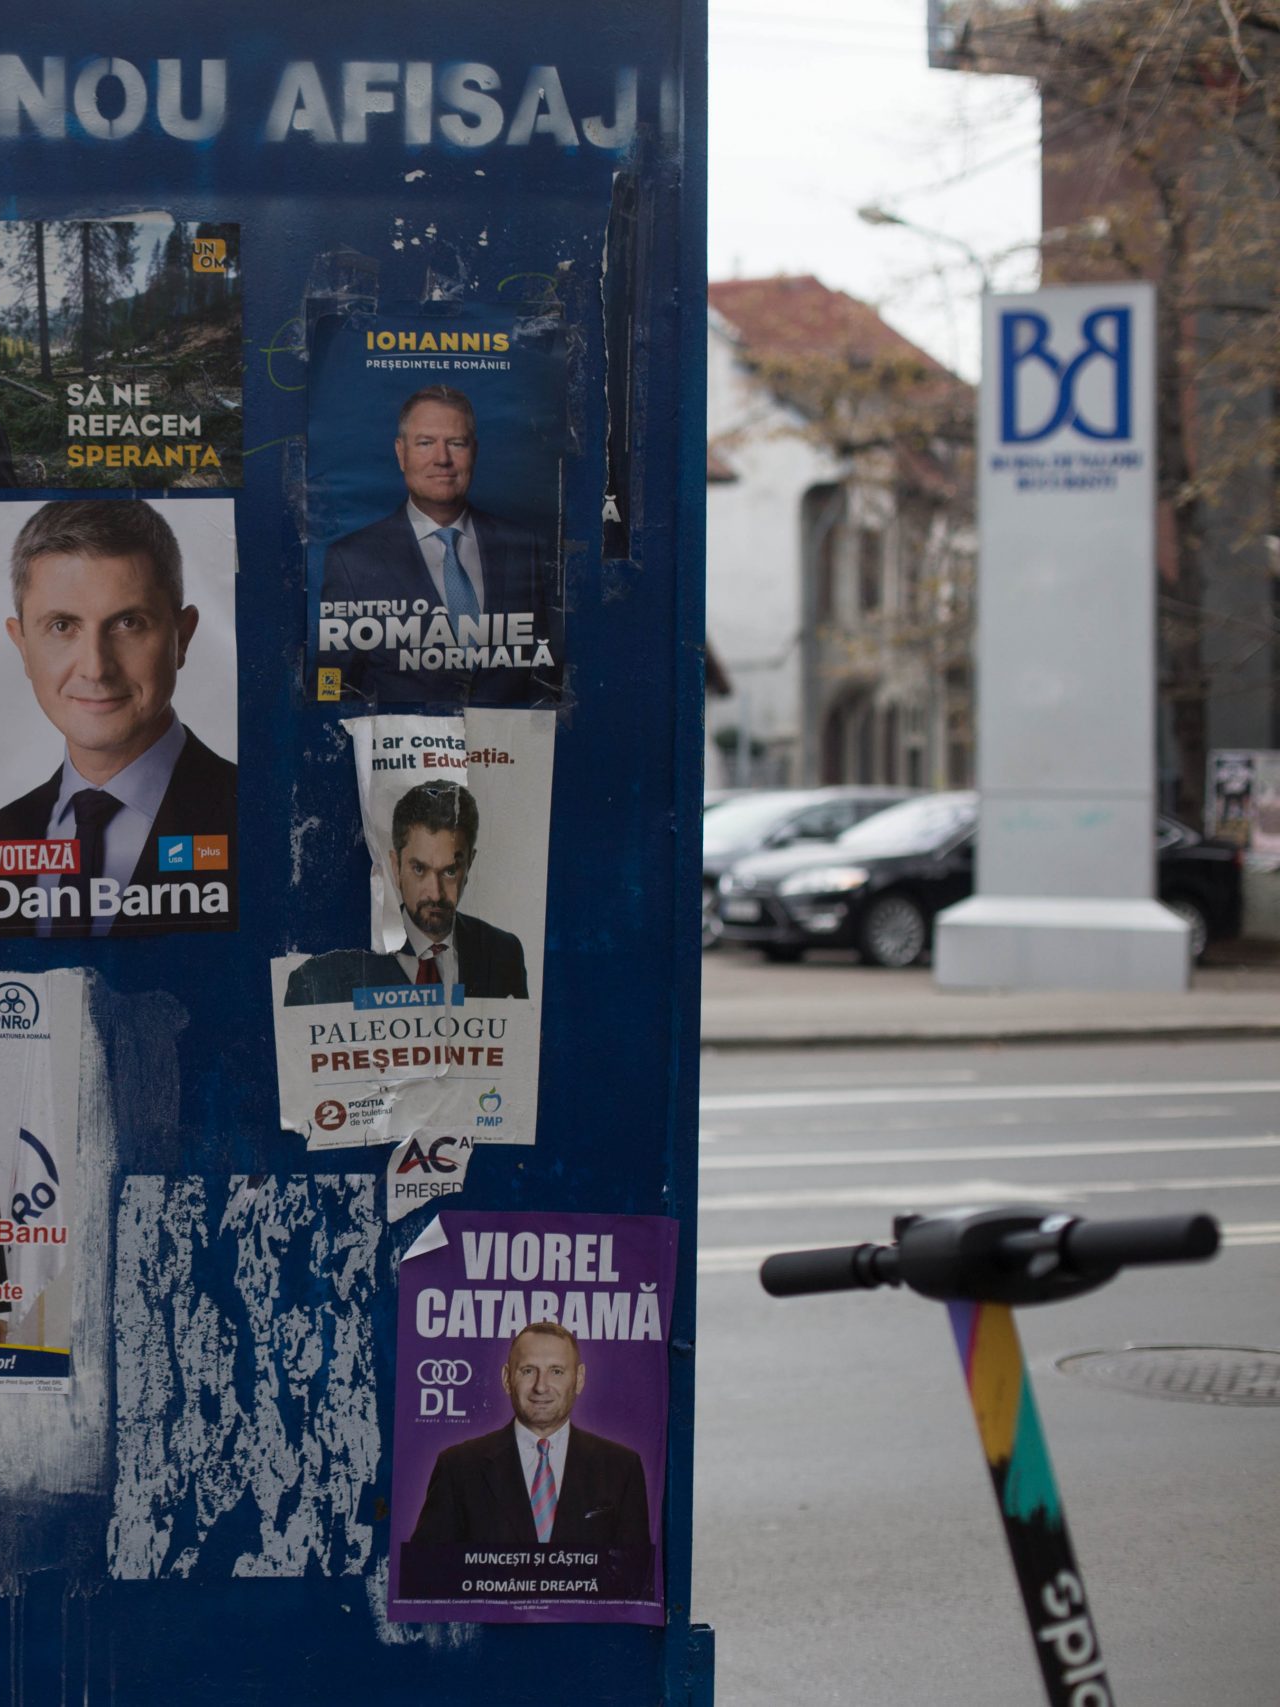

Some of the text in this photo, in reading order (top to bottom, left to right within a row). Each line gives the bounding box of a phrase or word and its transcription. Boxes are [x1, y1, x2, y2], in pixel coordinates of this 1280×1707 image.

[263, 60, 638, 149] AFISAJ
[193, 242, 215, 255] UN
[366, 331, 510, 351] IOHANNIS
[366, 360, 511, 371] PREȘEDINTELE ROMÂNIEI
[67, 375, 151, 406] SĂ NE
[68, 414, 201, 437] REFACEM
[67, 445, 222, 475] SPERANȚA
[320, 598, 429, 618] PENTRU O
[319, 606, 535, 651] ROMÂNIE
[399, 638, 555, 671] NORMALĂ
[382, 737, 404, 750] ar
[372, 754, 416, 771] mult
[90, 878, 229, 917] Barna
[373, 989, 437, 1007] VOTAȚI
[308, 1016, 508, 1045] PALEOLOGU
[310, 1045, 504, 1074] PREȘEDINTE
[350, 1117, 374, 1126] de vot
[476, 1116, 503, 1127] PMP
[461, 1231, 620, 1282] VIOREL
[415, 1282, 663, 1341] CATARAMĂ
[420, 1388, 466, 1417] DL
[464, 1550, 598, 1567] MUNCEȘTI ȘI CÂȘTIGI
[462, 1578, 599, 1592] O ROMÂNIE DREAPTĂ
